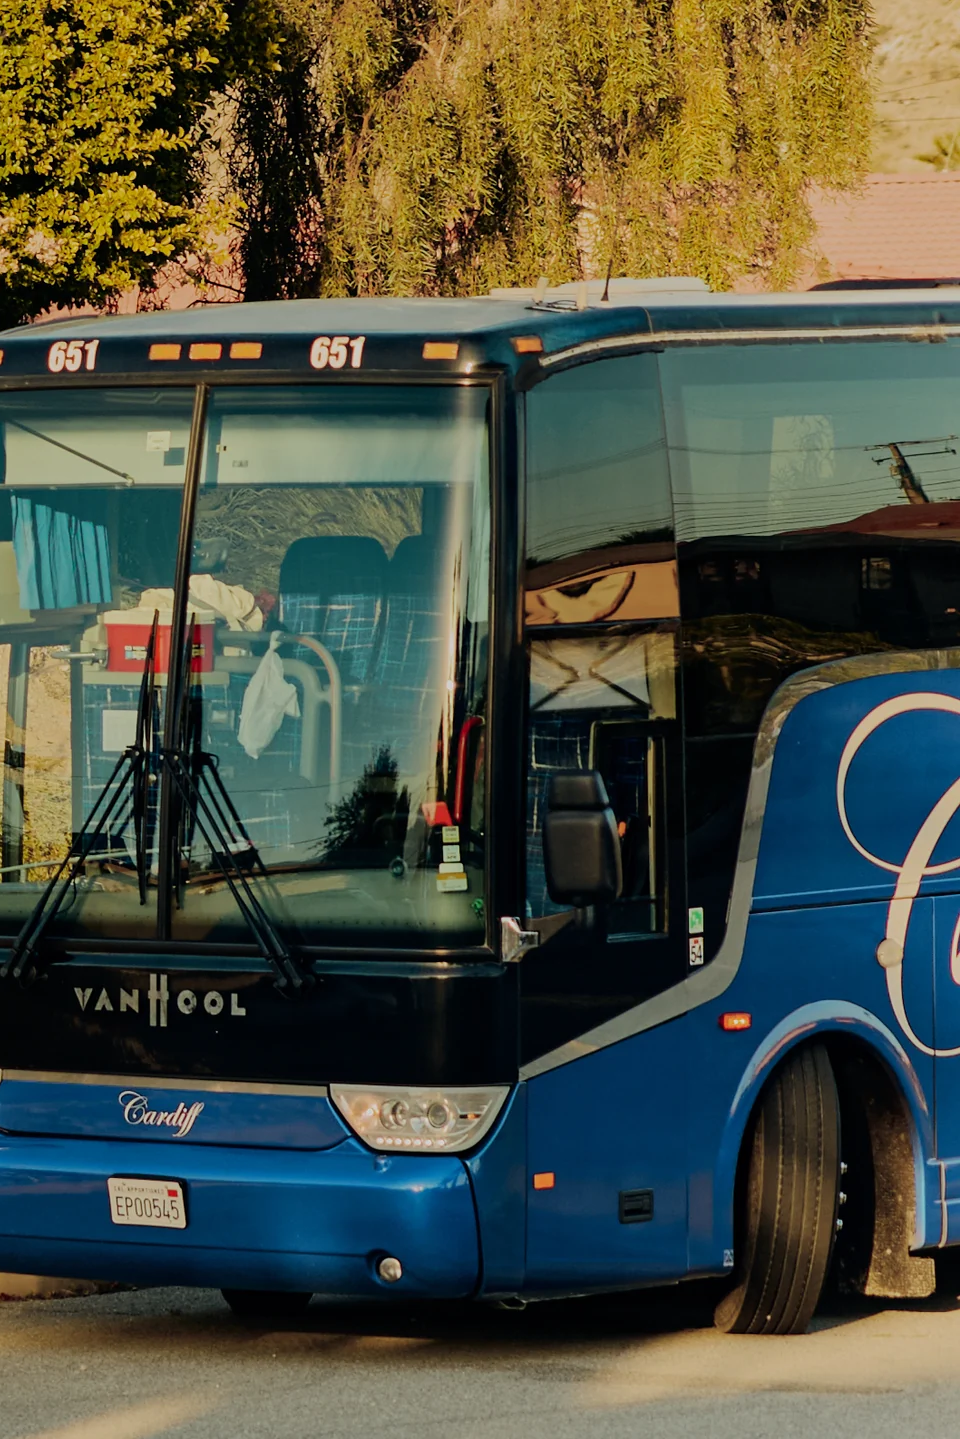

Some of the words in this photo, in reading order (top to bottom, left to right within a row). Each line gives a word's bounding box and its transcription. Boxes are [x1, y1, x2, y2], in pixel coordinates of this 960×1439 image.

[47, 338, 100, 373] 651
[309, 335, 366, 370] 651
[691, 944, 702, 963] 54
[118, 1090, 205, 1138] Cardiff
[115, 1196, 180, 1220] EP00545
